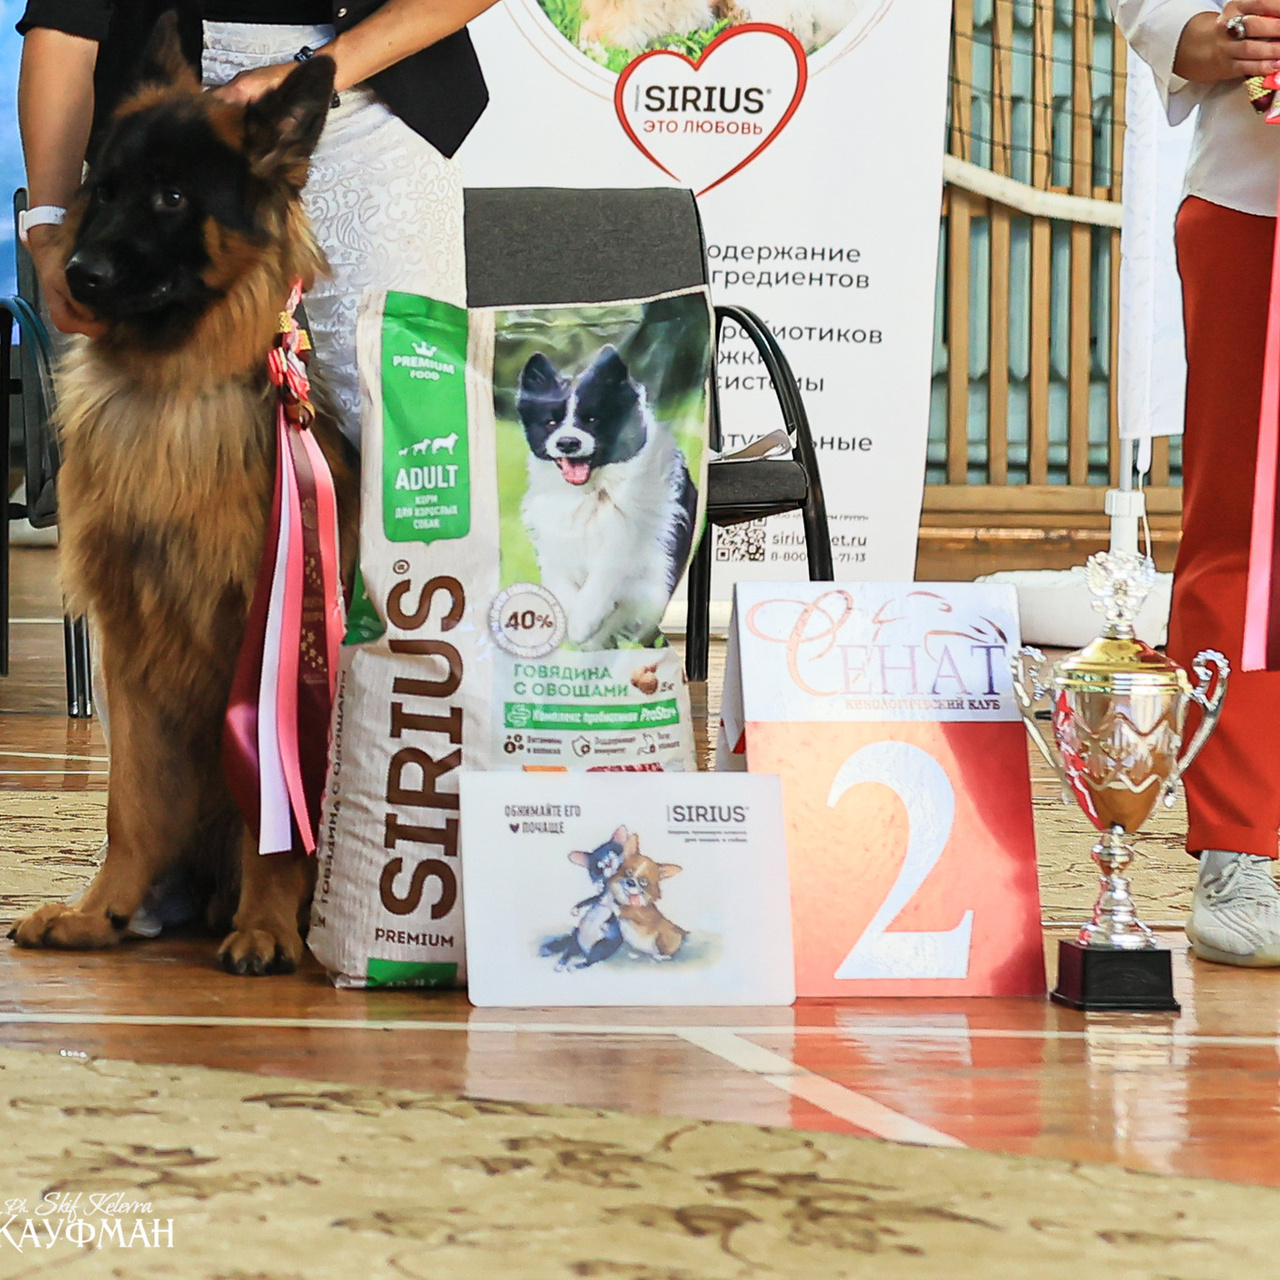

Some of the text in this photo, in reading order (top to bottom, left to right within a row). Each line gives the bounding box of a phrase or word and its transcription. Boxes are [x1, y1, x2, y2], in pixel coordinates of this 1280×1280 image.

[643, 85, 765, 115] SIRIUS
[643, 120, 764, 137] ЭТО ЛЮБОВЬ
[722, 319, 883, 345] роиотиков
[392, 355, 456, 376] PREMIUM
[409, 369, 441, 382] FOOD
[394, 464, 459, 492] ADULT
[505, 609, 554, 631] 40%
[514, 663, 613, 682] ГОВЯДИНА
[513, 681, 629, 698] С ОВОЩАМИ
[968, 698, 1001, 711] КЛУБ
[380, 575, 466, 920] SIRIUS
[672, 805, 746, 823] SIRIUS
[827, 740, 974, 980] 2
[375, 927, 454, 949] PREMIUM
